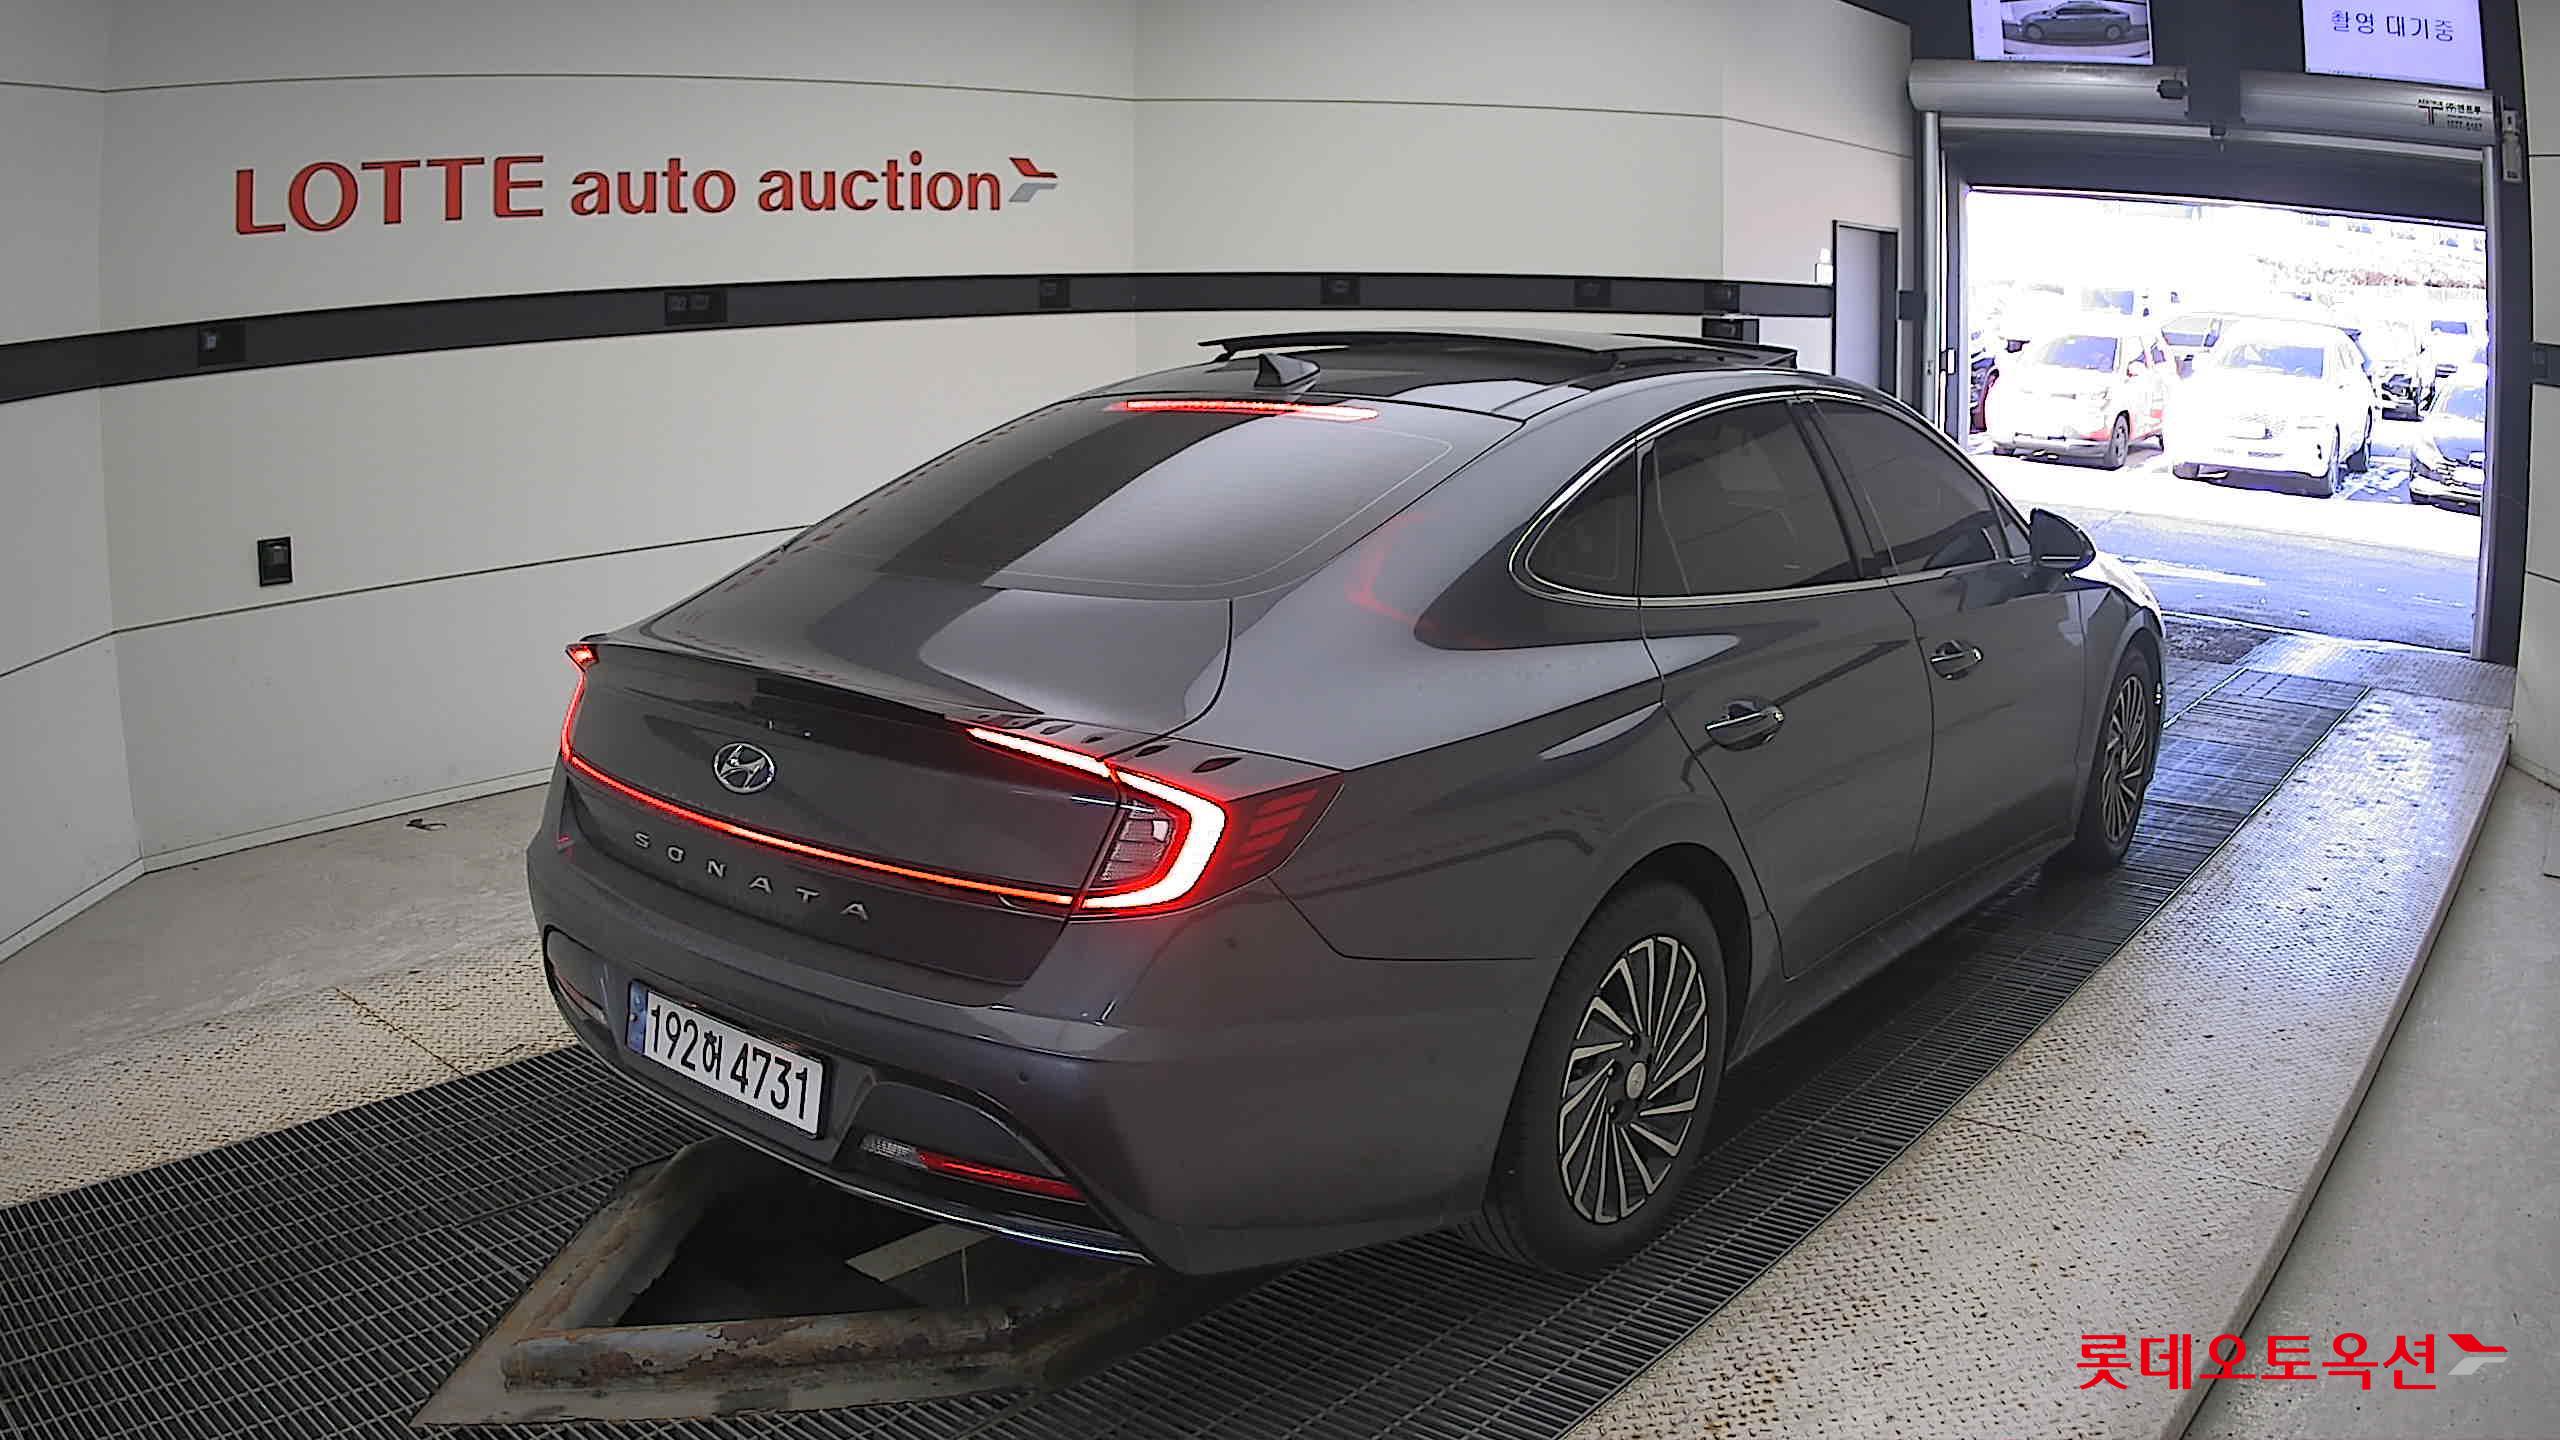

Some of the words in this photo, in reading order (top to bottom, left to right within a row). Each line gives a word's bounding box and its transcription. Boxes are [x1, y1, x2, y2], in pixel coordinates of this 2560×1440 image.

[2331, 10, 2375, 35] 촬영
[2386, 15, 2454, 42] 대기중
[236, 155, 545, 235] LOTTE
[571, 158, 737, 215] auto
[758, 151, 1001, 212] auction
[633, 832, 870, 921] SONATA
[651, 1004, 723, 1081] 192허
[730, 1042, 809, 1120] 4731
